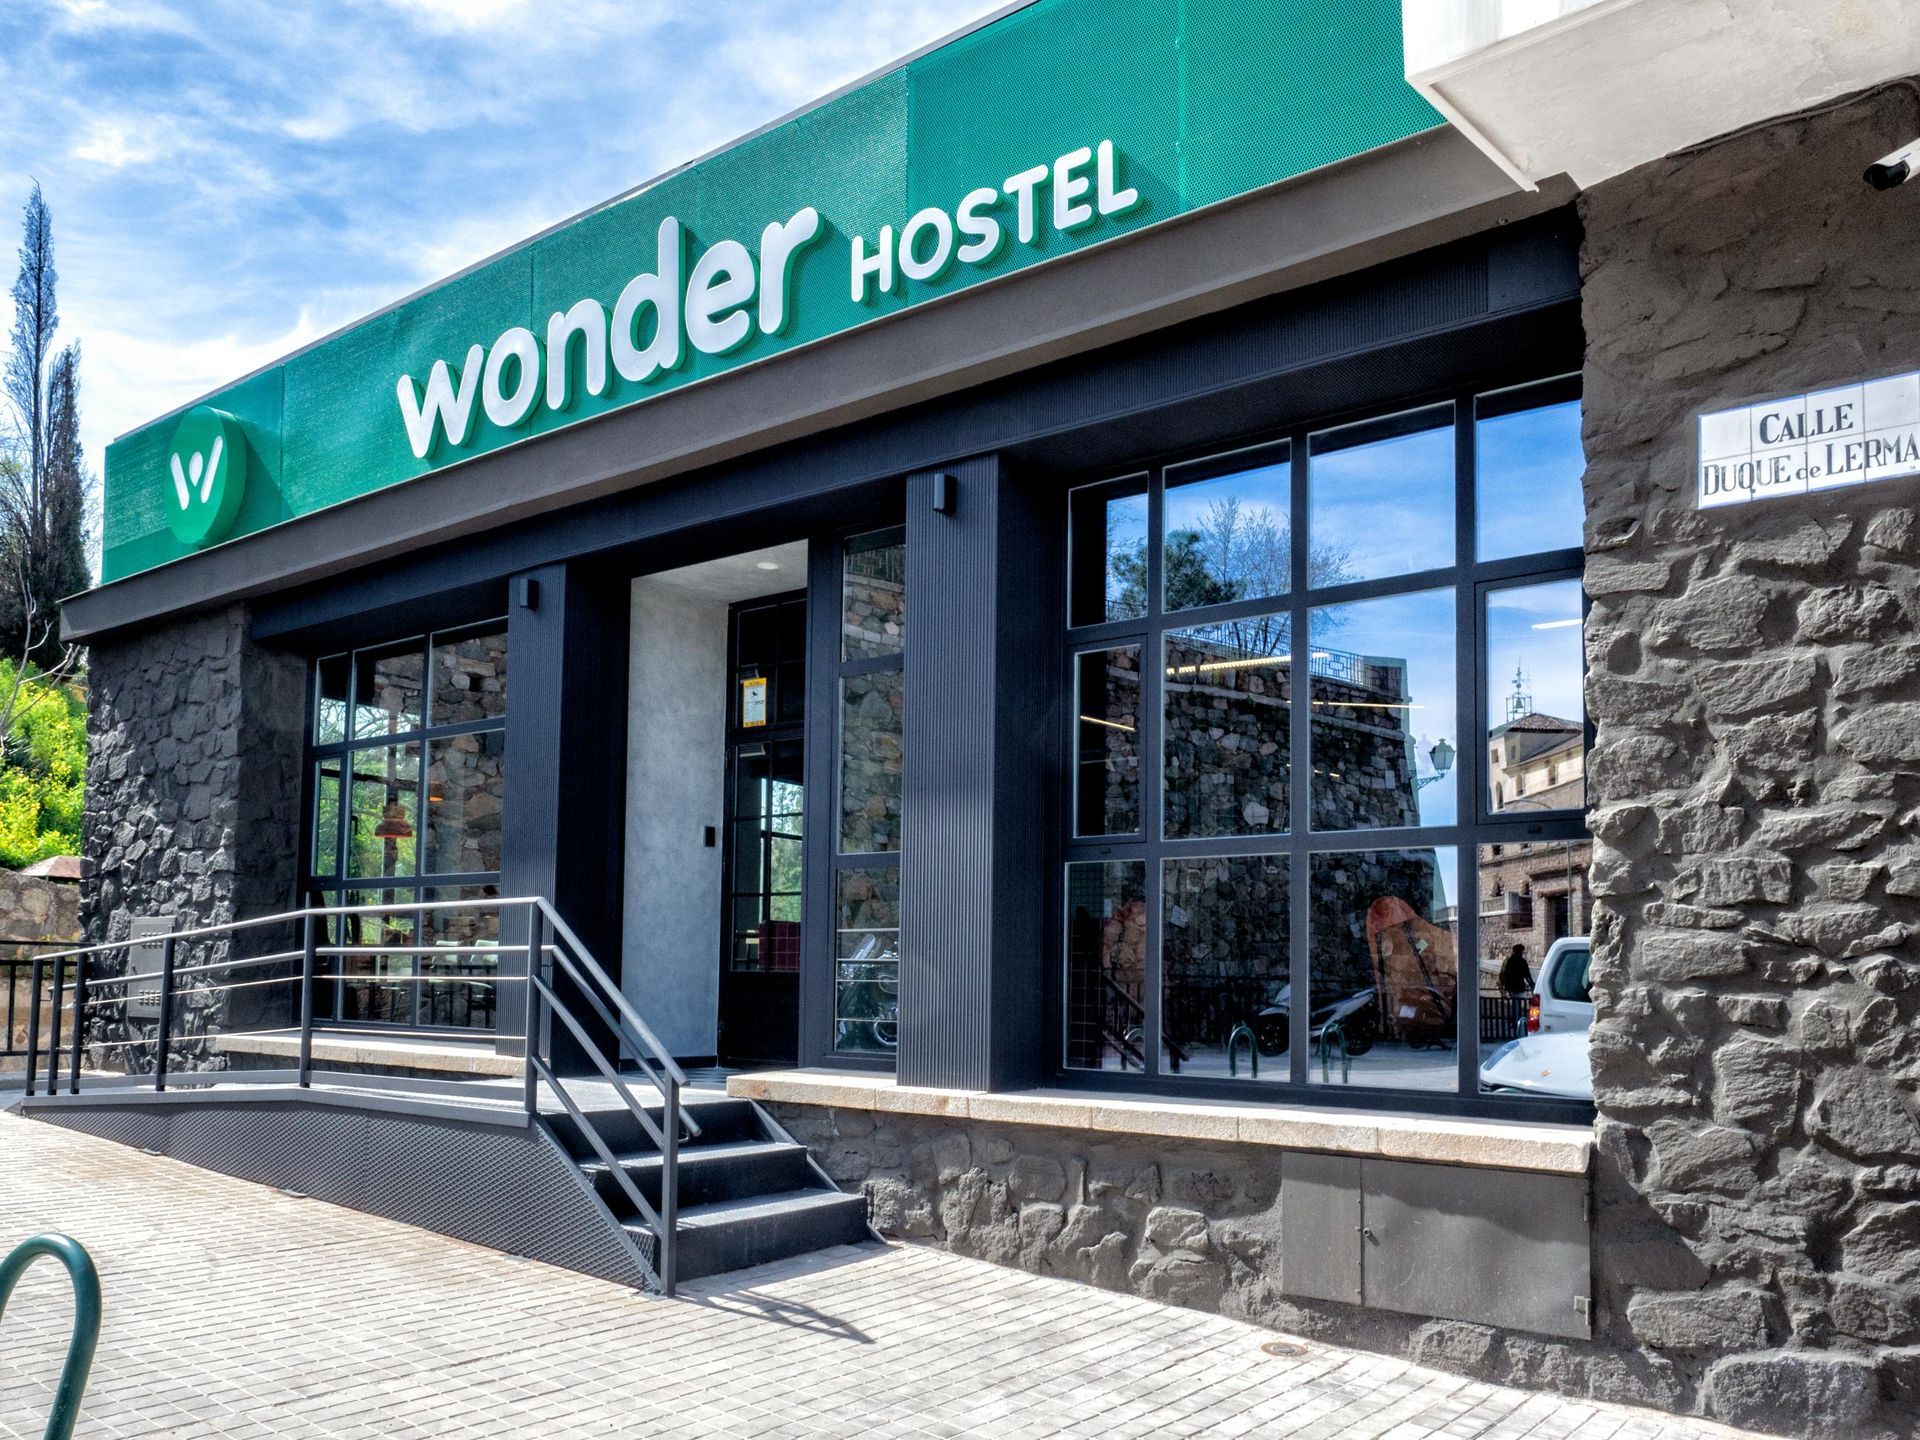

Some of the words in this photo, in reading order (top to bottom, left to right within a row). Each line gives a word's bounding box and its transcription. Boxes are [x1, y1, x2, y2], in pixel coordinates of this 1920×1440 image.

[396, 208, 823, 459] wonder
[850, 140, 1138, 303] HOSTEL
[1759, 403, 1853, 445] CALLE
[1703, 455, 1791, 496] DUQUE
[1795, 452, 1821, 480] de
[1825, 433, 1920, 476] LERMA
